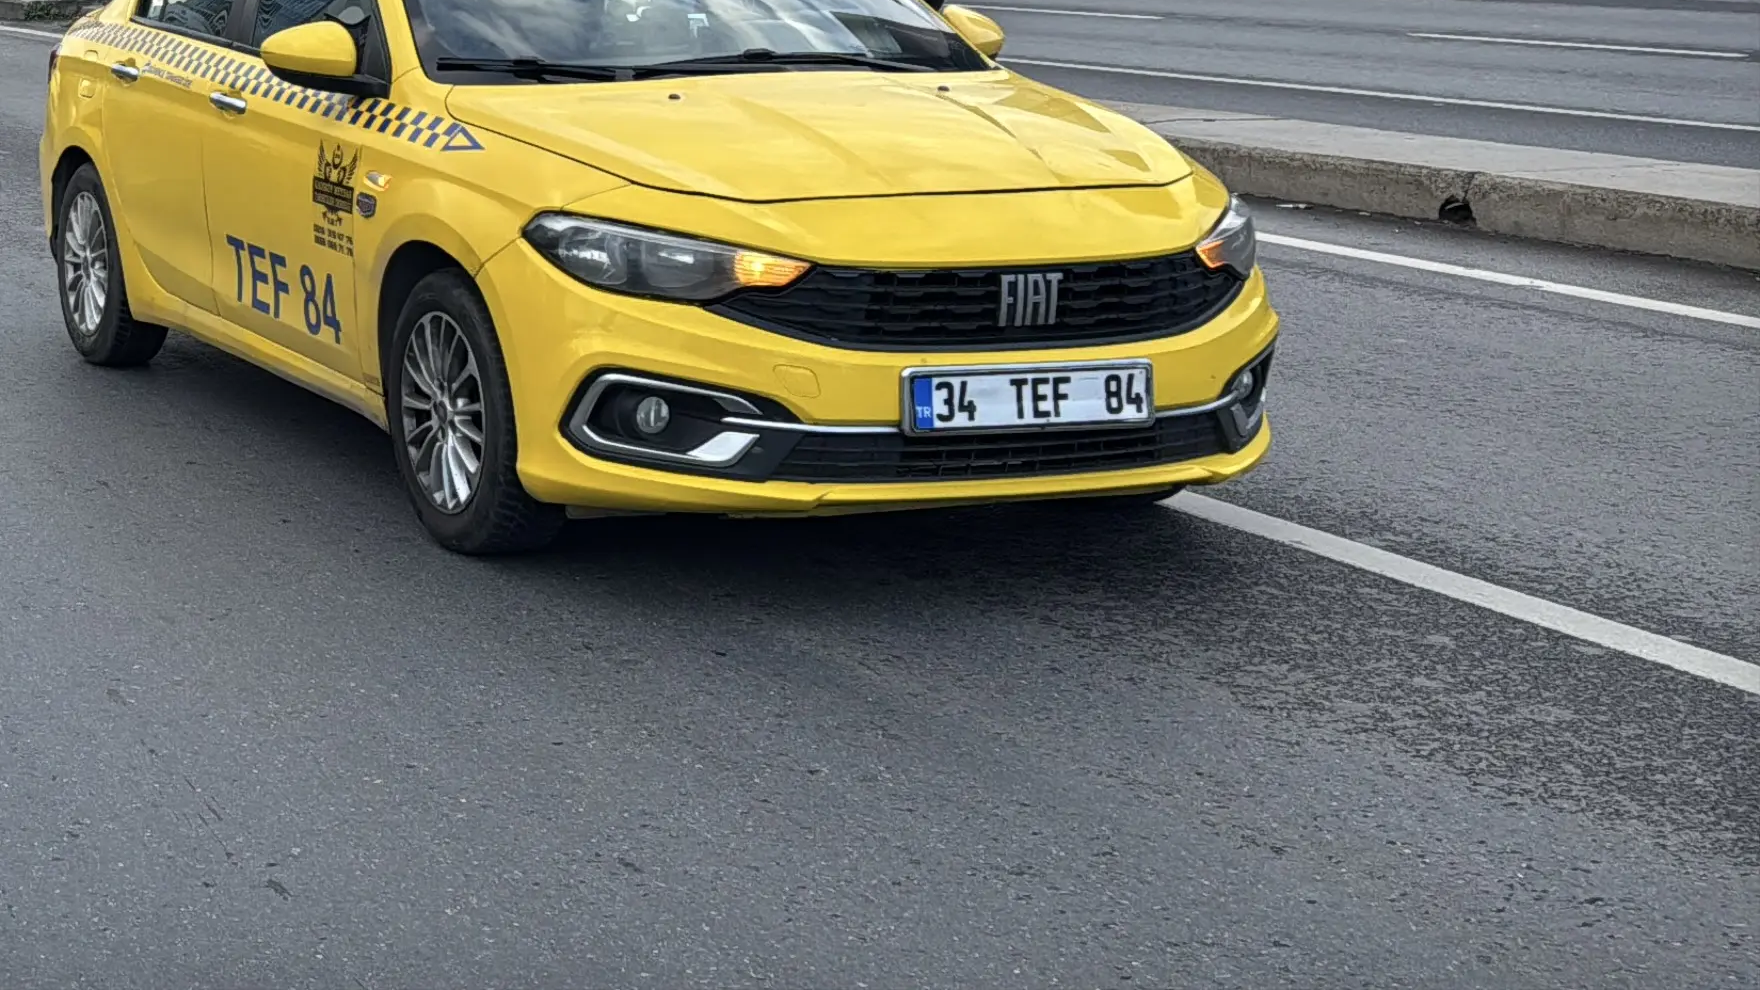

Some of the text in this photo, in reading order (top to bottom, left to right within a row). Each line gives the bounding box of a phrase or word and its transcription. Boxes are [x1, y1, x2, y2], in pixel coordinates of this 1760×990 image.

[225, 233, 342, 345] TEF 84
[997, 272, 1064, 327] FIAT
[916, 373, 1144, 423] TR 34 TEF 84
